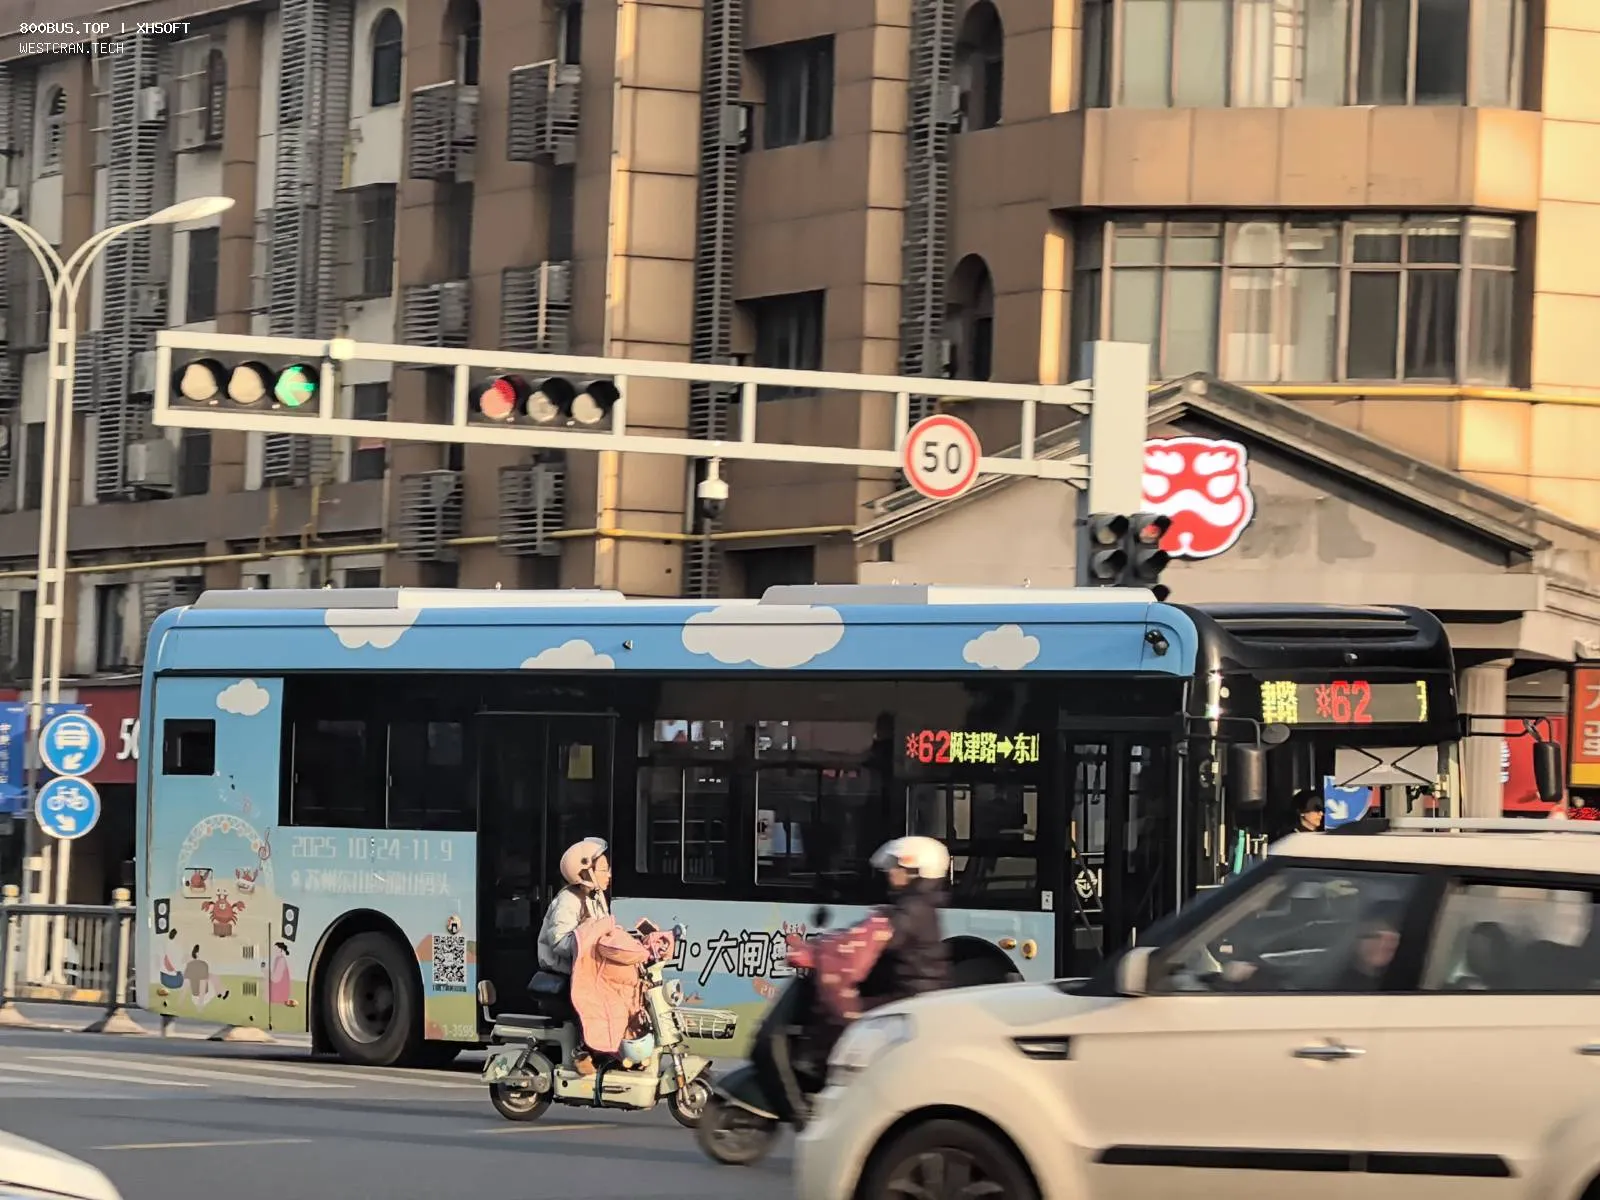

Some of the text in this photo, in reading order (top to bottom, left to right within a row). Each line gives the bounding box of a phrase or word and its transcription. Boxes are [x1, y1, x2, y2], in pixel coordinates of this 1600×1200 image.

[923, 441, 962, 474] 50
[1331, 680, 1373, 723] 62
[919, 729, 950, 763] 62
